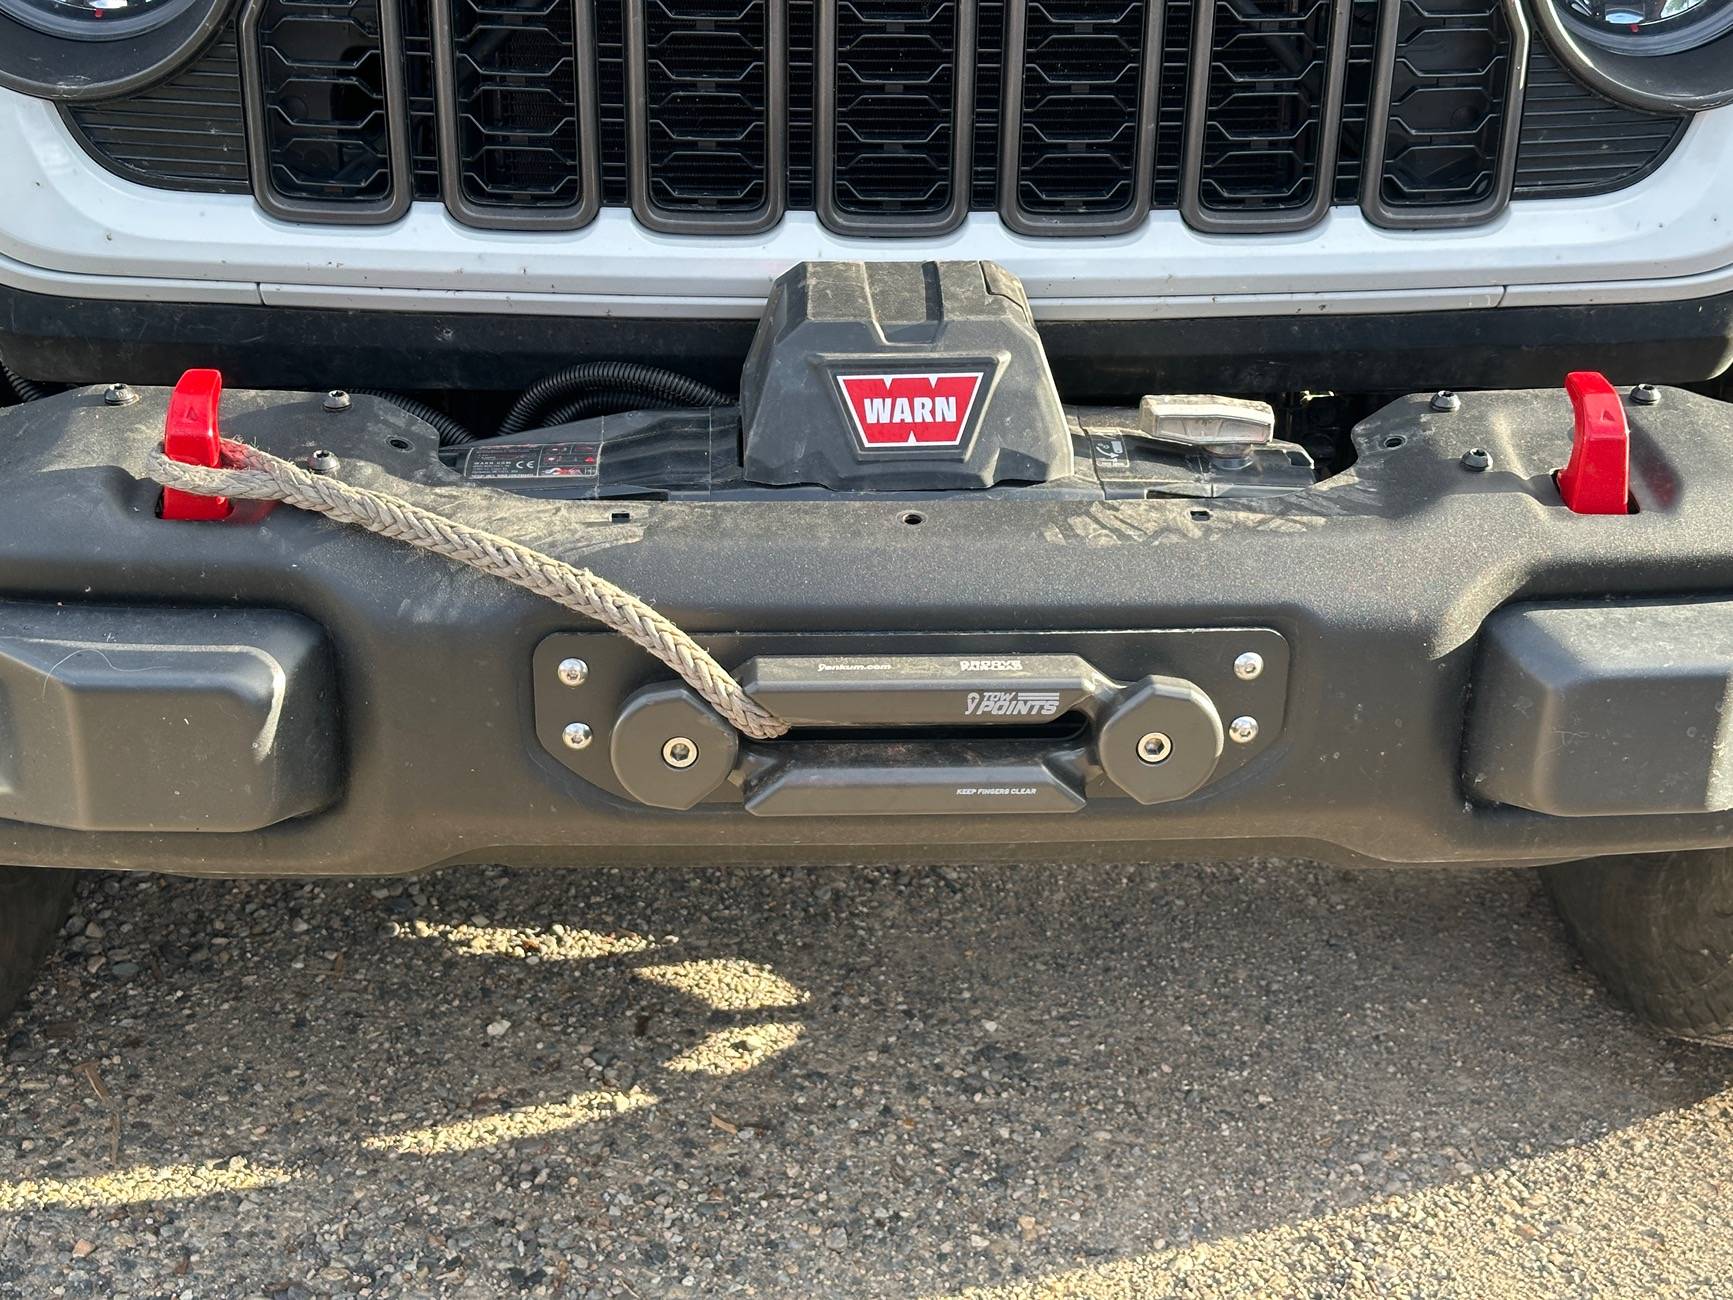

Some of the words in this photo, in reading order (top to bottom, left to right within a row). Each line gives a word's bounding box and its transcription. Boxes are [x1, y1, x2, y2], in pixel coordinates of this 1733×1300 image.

[863, 396, 957, 424] WARN
[983, 692, 1016, 701] TOW
[976, 700, 1060, 715] POINTS
